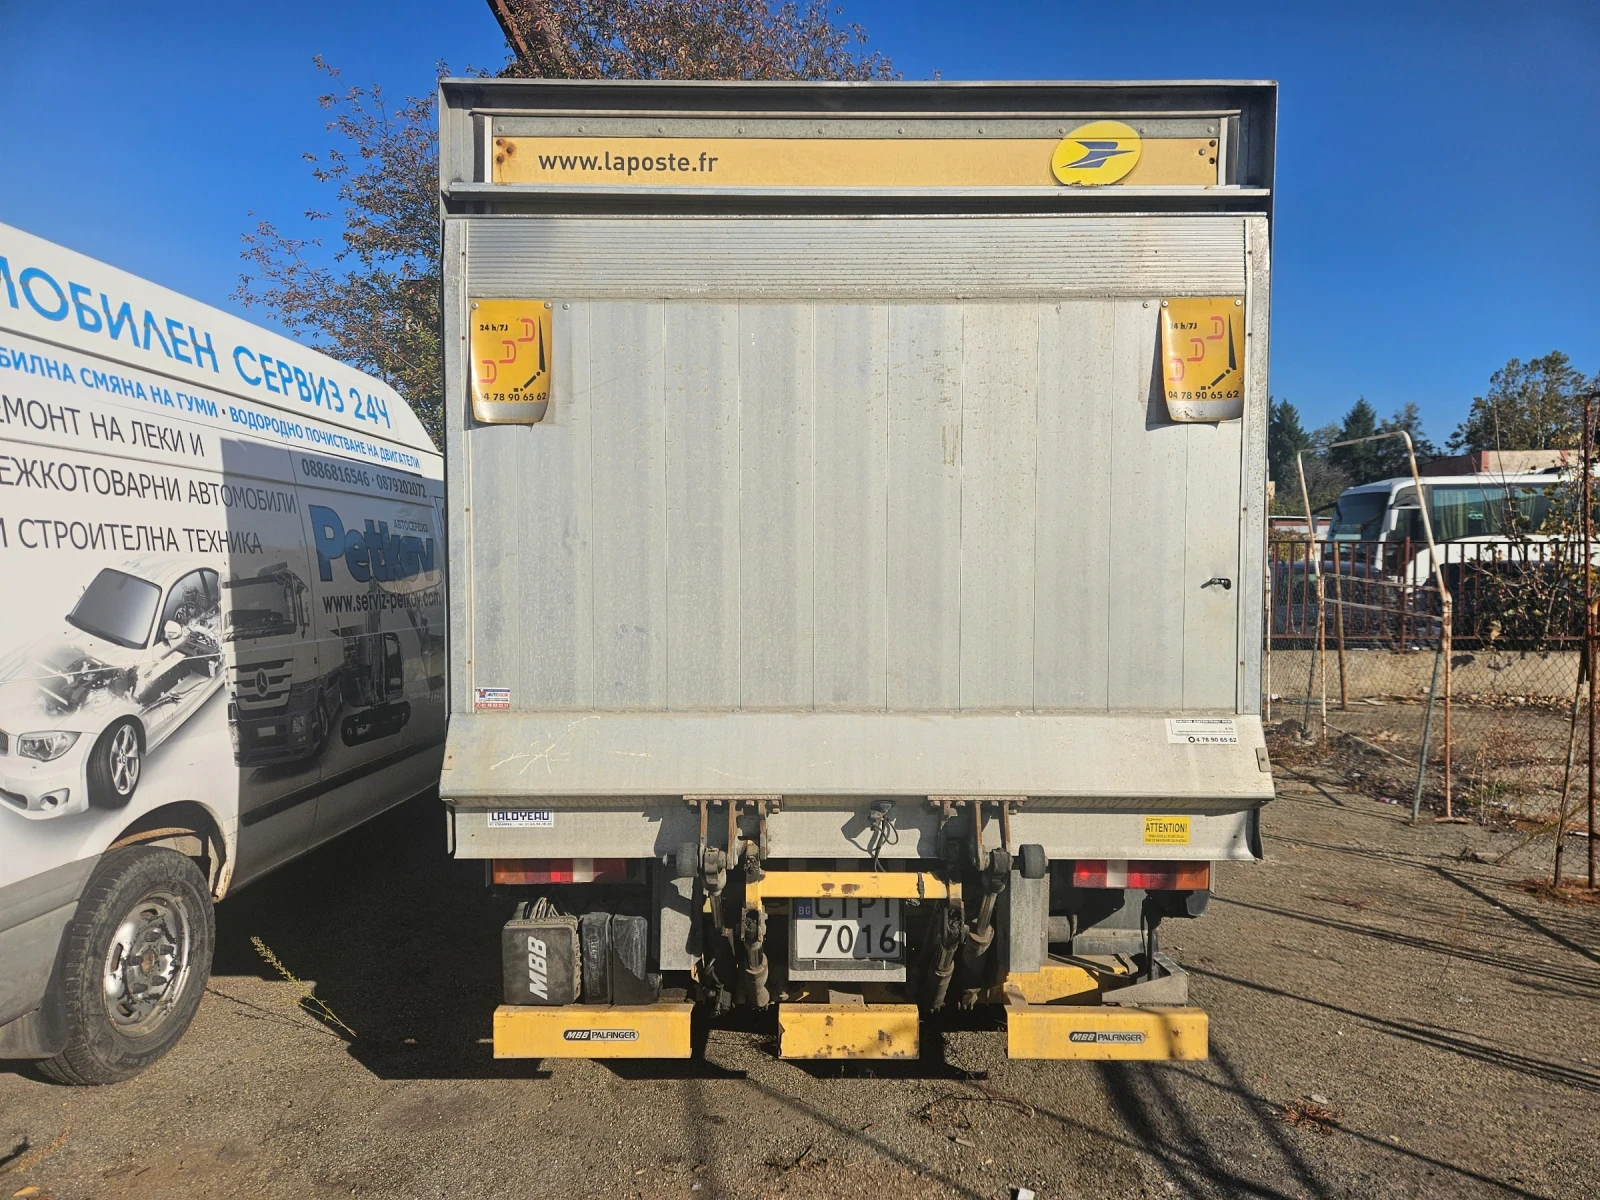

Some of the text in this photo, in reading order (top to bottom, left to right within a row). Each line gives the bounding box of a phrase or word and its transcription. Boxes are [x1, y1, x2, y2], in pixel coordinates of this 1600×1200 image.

[538, 151, 718, 176] www.laposte.fr
[233, 345, 344, 413] СЕРВИЗ
[523, 393, 534, 401] 65
[536, 392, 547, 400] 62
[1168, 391, 1178, 399] 04
[1195, 392, 1207, 400] 90
[1210, 391, 1223, 399] 65
[1226, 390, 1239, 398] 62
[80, 367, 148, 401] СМЯНА
[150, 385, 175, 407] НА
[176, 392, 219, 418] ГУМИ
[229, 406, 304, 439] ВОДОРОДНО
[304, 426, 367, 453] ПОЧИСТВАНЕ
[368, 443, 379, 458] НА
[380, 447, 420, 469] ДВИГАТЕЛИ
[90, 412, 125, 443] НА
[131, 420, 185, 454] ЛЕКИ
[189, 432, 205, 457] И
[301, 458, 427, 499] 0886816546 0879202072
[188, 480, 297, 514] АВТОМОБИЛИ
[18, 518, 180, 552] СТРОИТЕЛНА
[182, 528, 264, 555] ТЕХНИКА
[308, 504, 434, 583] Petkov
[322, 589, 442, 614] www.serviz-petkov.com
[491, 811, 549, 821] LALOYEAU
[1145, 823, 1187, 833] ATTENTION!
[798, 906, 811, 915] BG
[815, 924, 896, 954] 7016
[528, 936, 548, 1000] MBB
[566, 1031, 636, 1039] MBB PALFINGER
[1071, 1033, 1142, 1041] MBB PALFINGER
